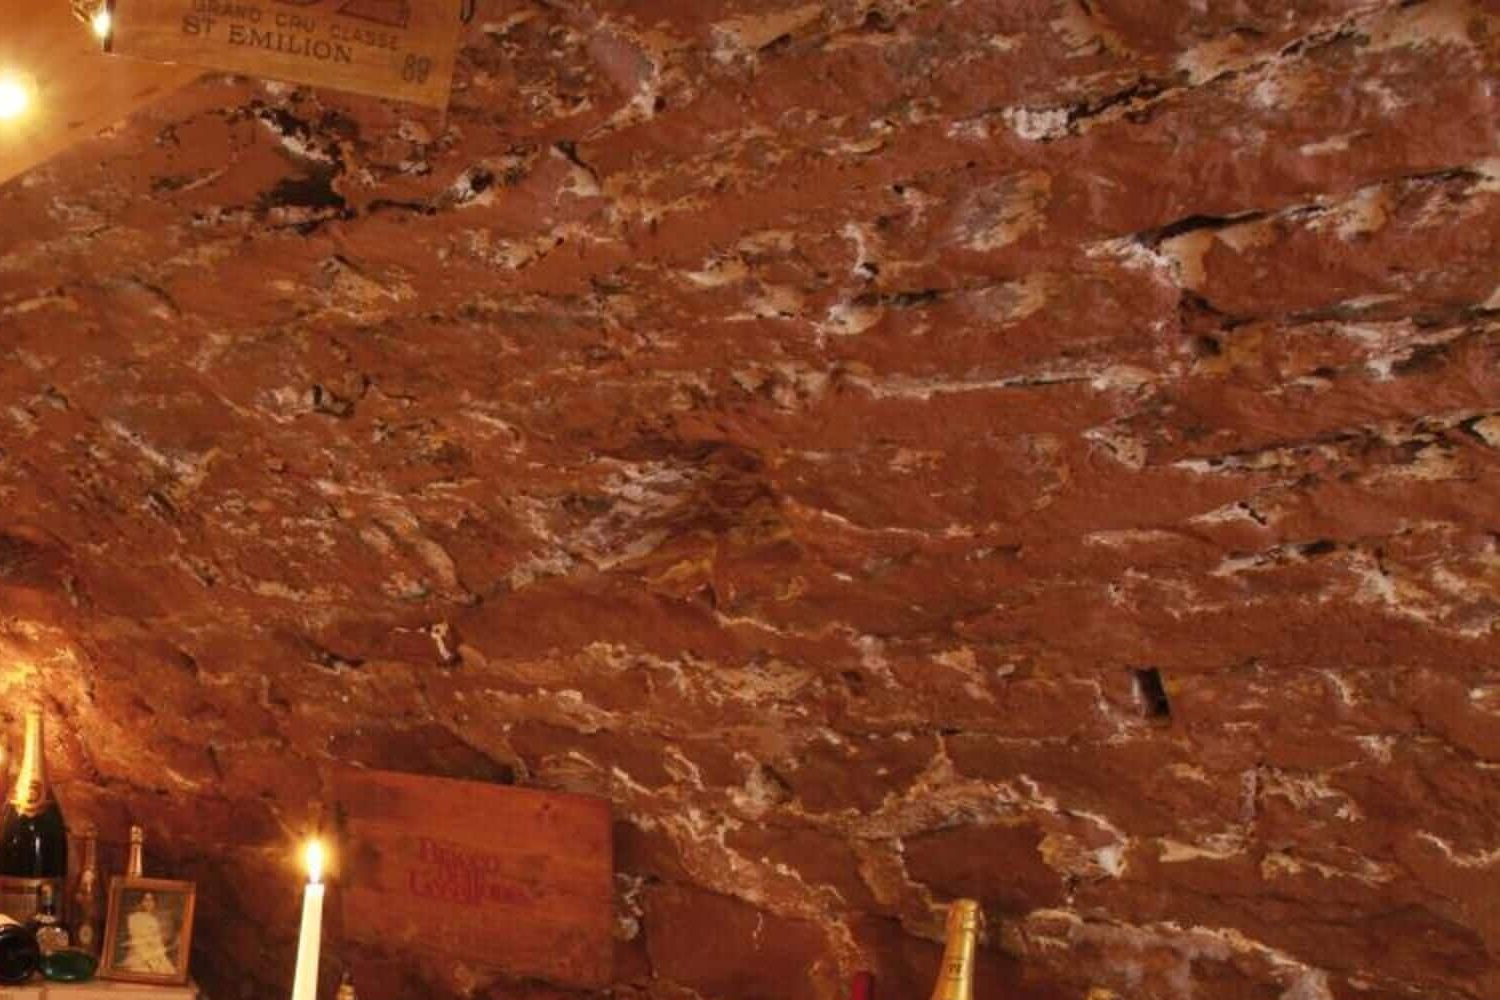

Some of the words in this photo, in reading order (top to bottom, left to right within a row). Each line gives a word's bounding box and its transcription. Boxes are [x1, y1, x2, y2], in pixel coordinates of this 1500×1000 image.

[181, 15, 214, 34] ST
[228, 24, 354, 64] EMILION
[275, 13, 317, 33] CRU
